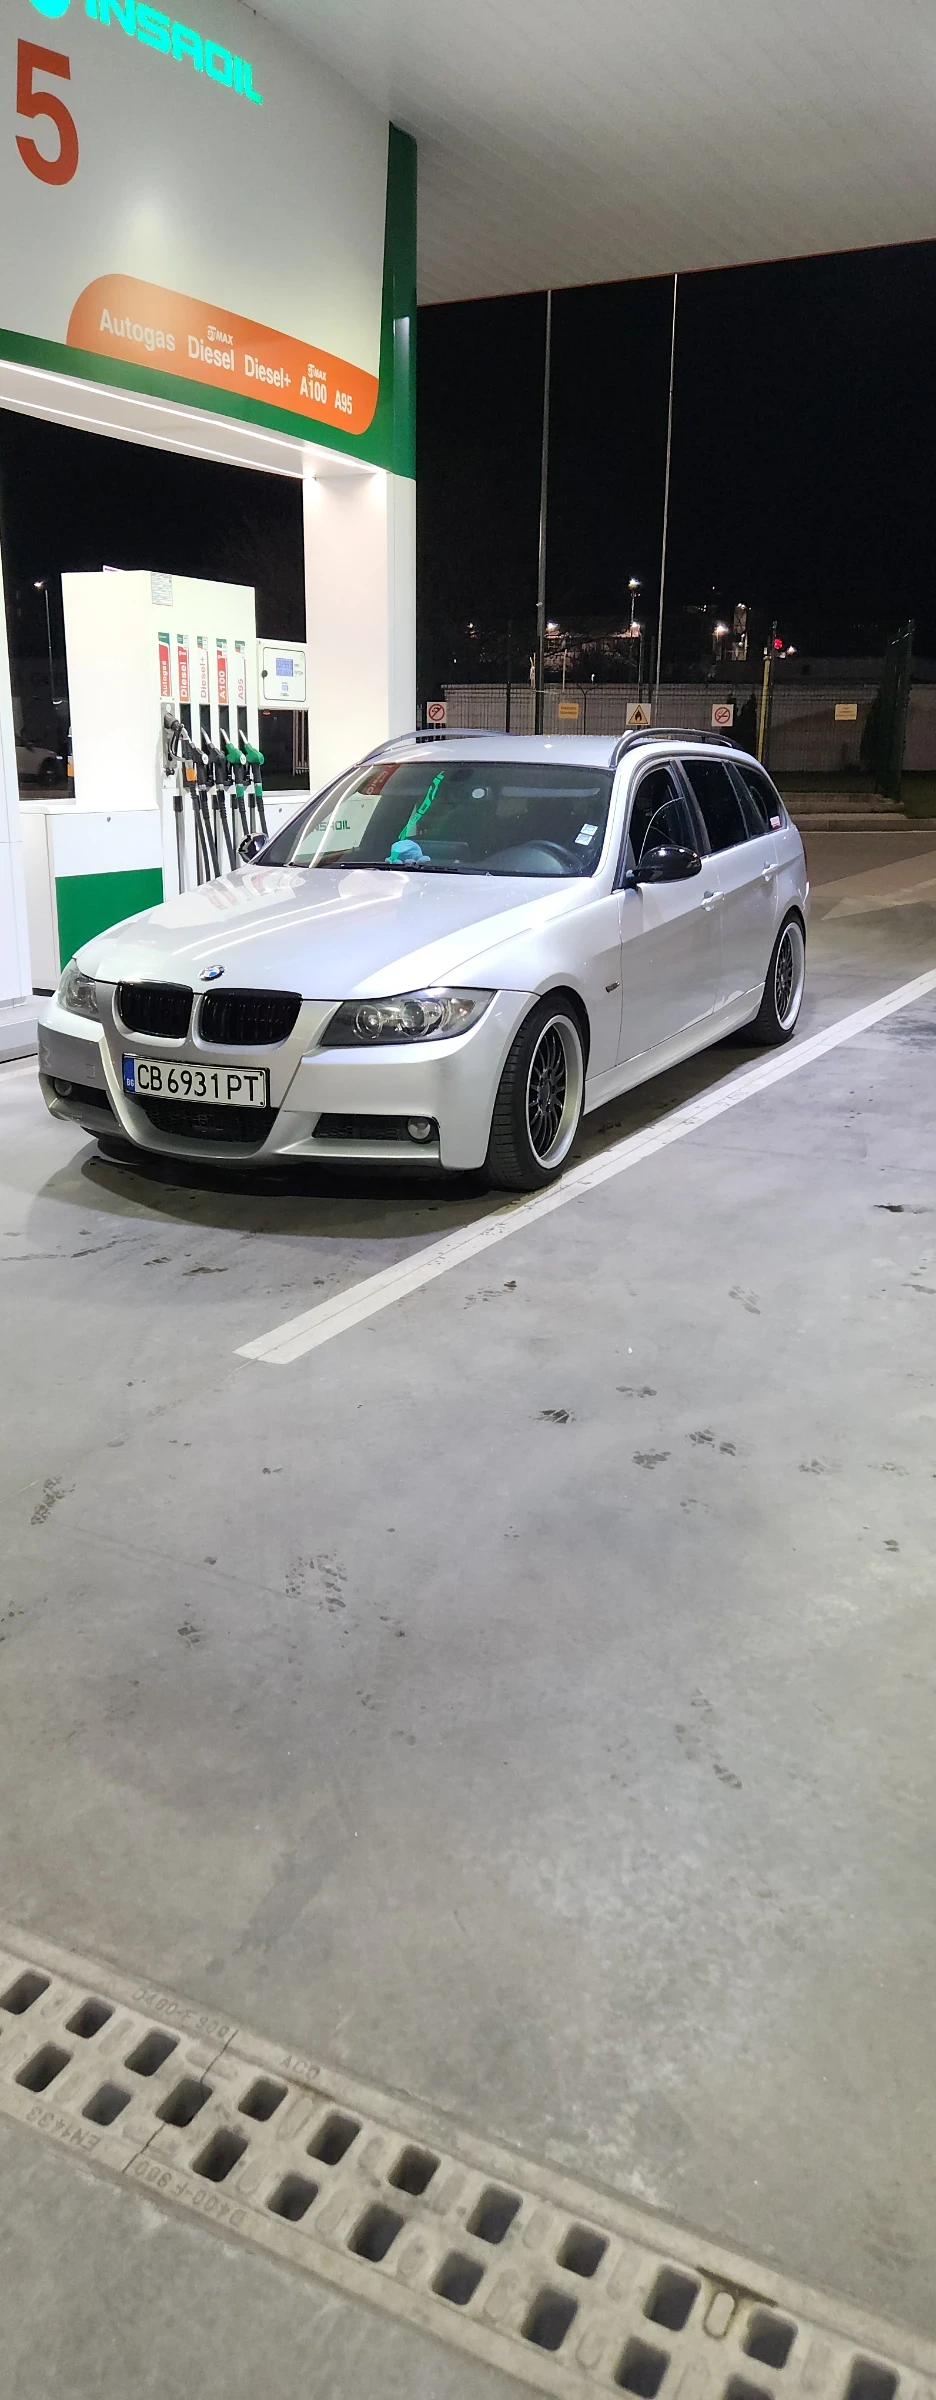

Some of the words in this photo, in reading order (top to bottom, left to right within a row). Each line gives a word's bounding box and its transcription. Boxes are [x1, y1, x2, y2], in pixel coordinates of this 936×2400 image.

[15, 38, 79, 186] 5
[100, 308, 176, 351] Autogas
[188, 335, 235, 371] Diesel
[244, 354, 291, 389] Diesel+
[300, 376, 327, 405] A100
[334, 390, 353, 415] A95
[180, 661, 188, 698] Diesel
[218, 670, 226, 699] A100
[126, 1079, 135, 1087] BG
[137, 1064, 162, 1091] CB
[167, 1068, 219, 1099] 6931
[227, 1074, 258, 1102] PT
